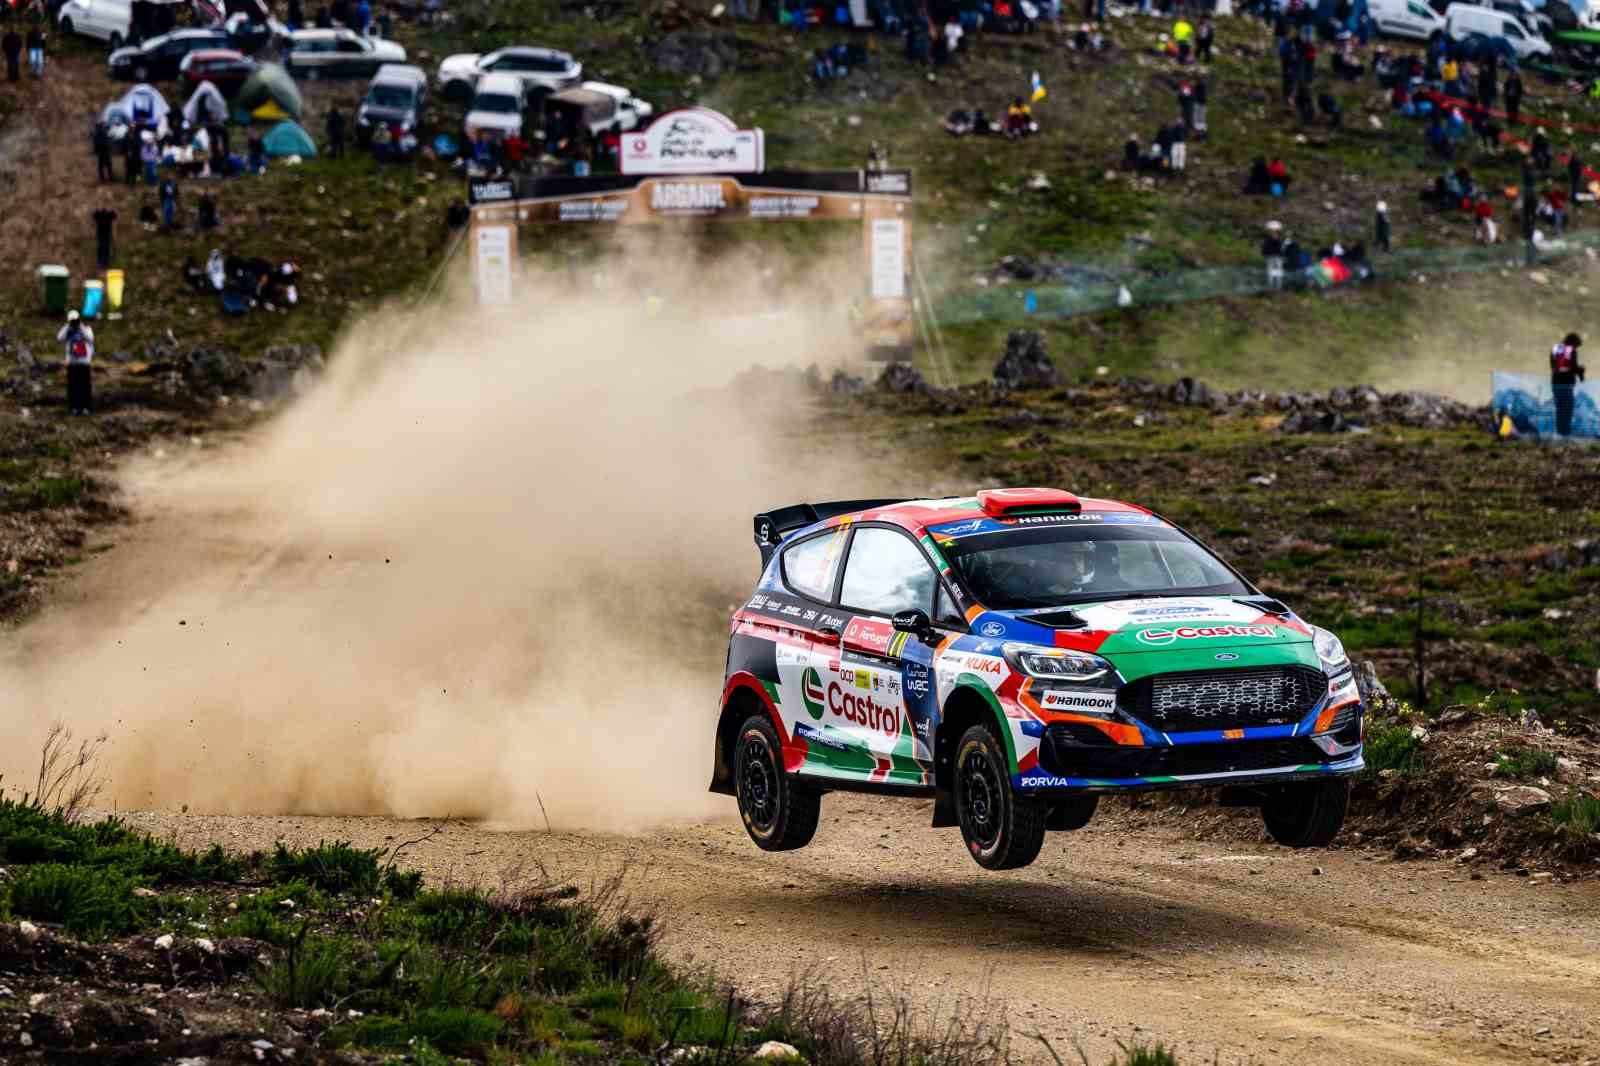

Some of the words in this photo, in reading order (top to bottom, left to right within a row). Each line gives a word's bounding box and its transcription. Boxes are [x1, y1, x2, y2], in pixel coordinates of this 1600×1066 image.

[1176, 626, 1275, 639] Castrol
[964, 656, 1000, 674] KUKA
[828, 681, 900, 740] Castrol
[1021, 776, 1068, 787] FORVIA
